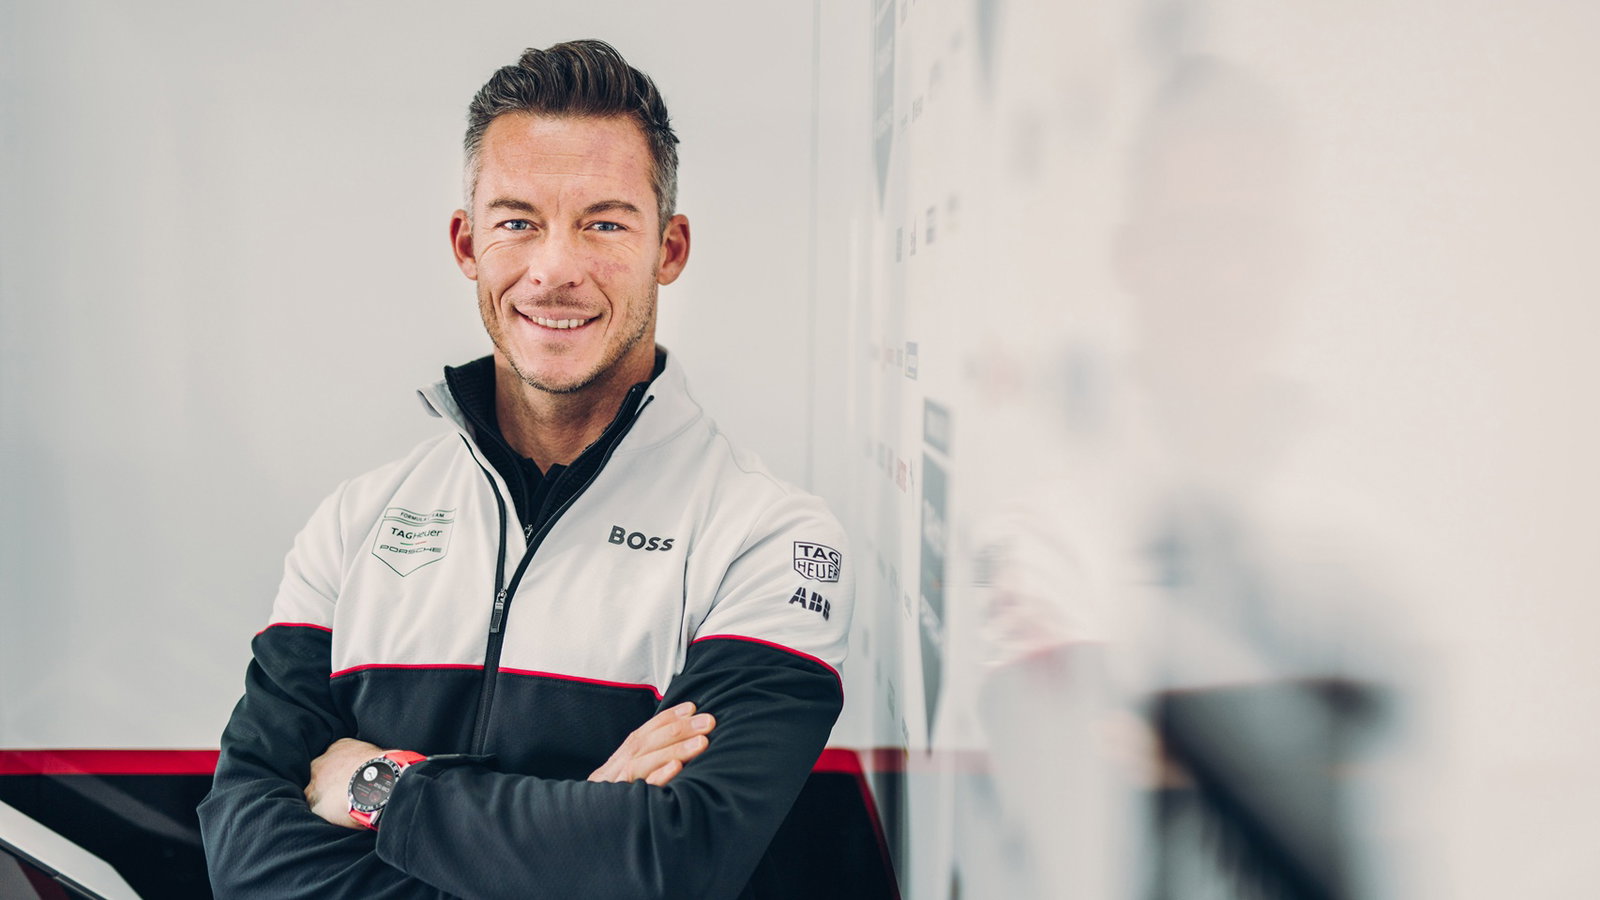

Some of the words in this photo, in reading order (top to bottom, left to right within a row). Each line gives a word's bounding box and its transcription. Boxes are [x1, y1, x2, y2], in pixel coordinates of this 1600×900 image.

[608, 525, 675, 551] BOSS
[380, 544, 442, 555] PORSCHE
[798, 545, 839, 566] TAG
